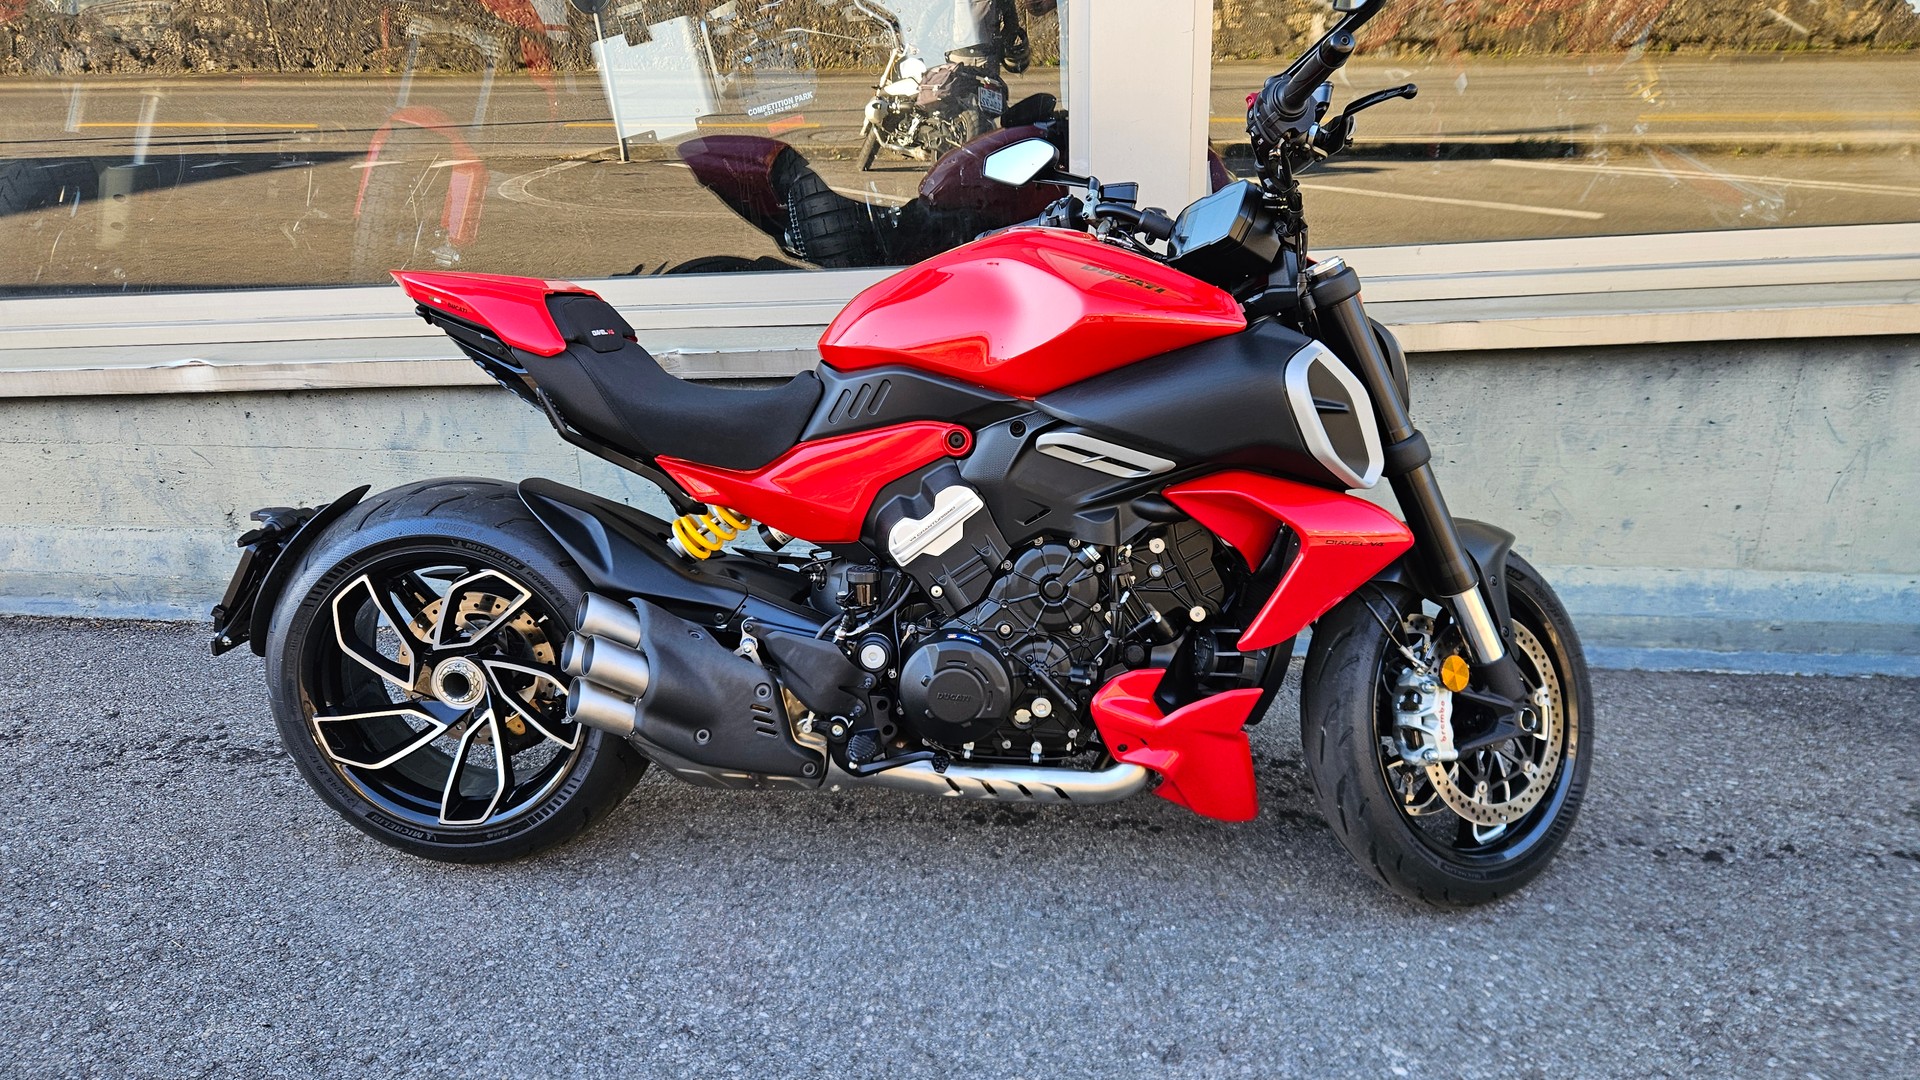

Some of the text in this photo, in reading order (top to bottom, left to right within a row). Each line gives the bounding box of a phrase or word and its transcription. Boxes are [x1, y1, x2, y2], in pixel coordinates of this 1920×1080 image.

[747, 91, 814, 117] COMPETITION PARK
[1081, 264, 1166, 294] DUCATI
[447, 302, 468, 313] DUCATI
[1325, 539, 1368, 547] DIAVEL
[464, 542, 523, 568] MICHELIN
[526, 571, 555, 596] POWER
[936, 692, 972, 702] DUCATI
[1438, 700, 1448, 743] brembo
[371, 813, 425, 840] MICHELIN
